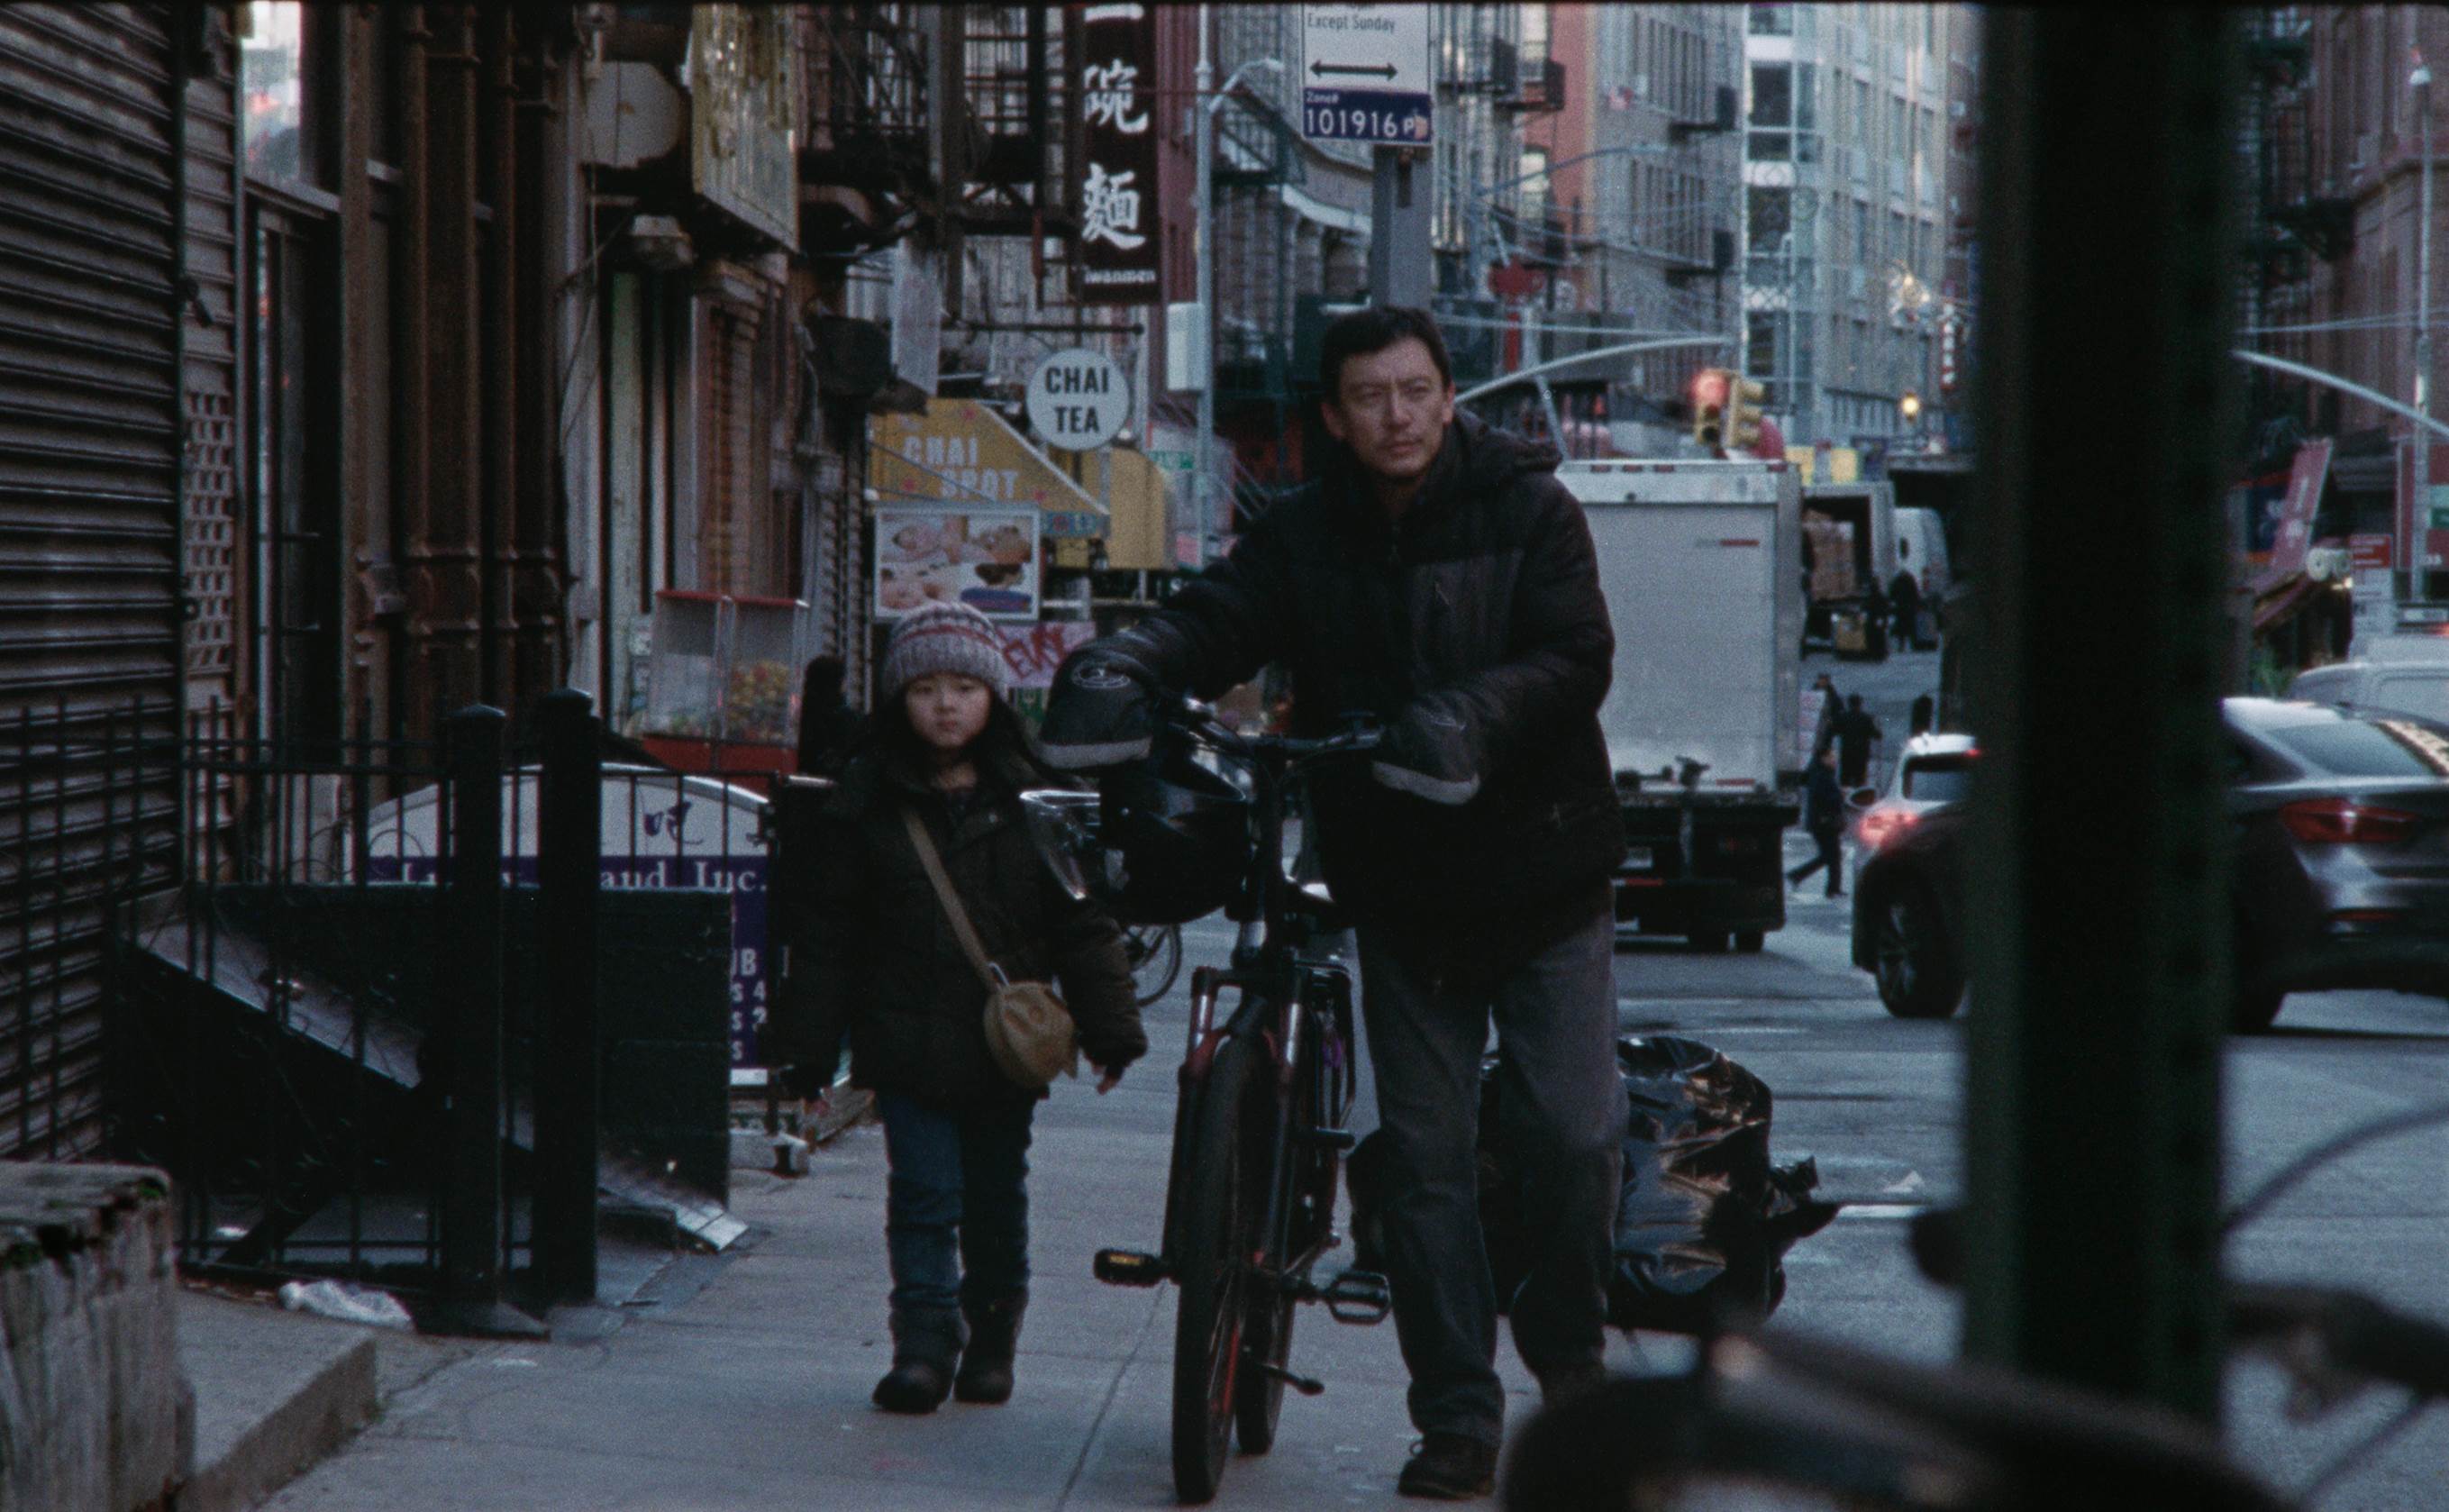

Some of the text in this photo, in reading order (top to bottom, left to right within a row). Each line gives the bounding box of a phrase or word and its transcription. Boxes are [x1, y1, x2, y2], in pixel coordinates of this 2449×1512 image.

[1307, 14, 1396, 33] Except Sunday
[1307, 109, 1397, 138] 101916
[1045, 366, 1110, 395] CHAI
[1054, 405, 1100, 434] TEA
[903, 435, 979, 467] CHAI
[941, 467, 1019, 502] SPOT
[696, 861, 768, 891] Inc.
